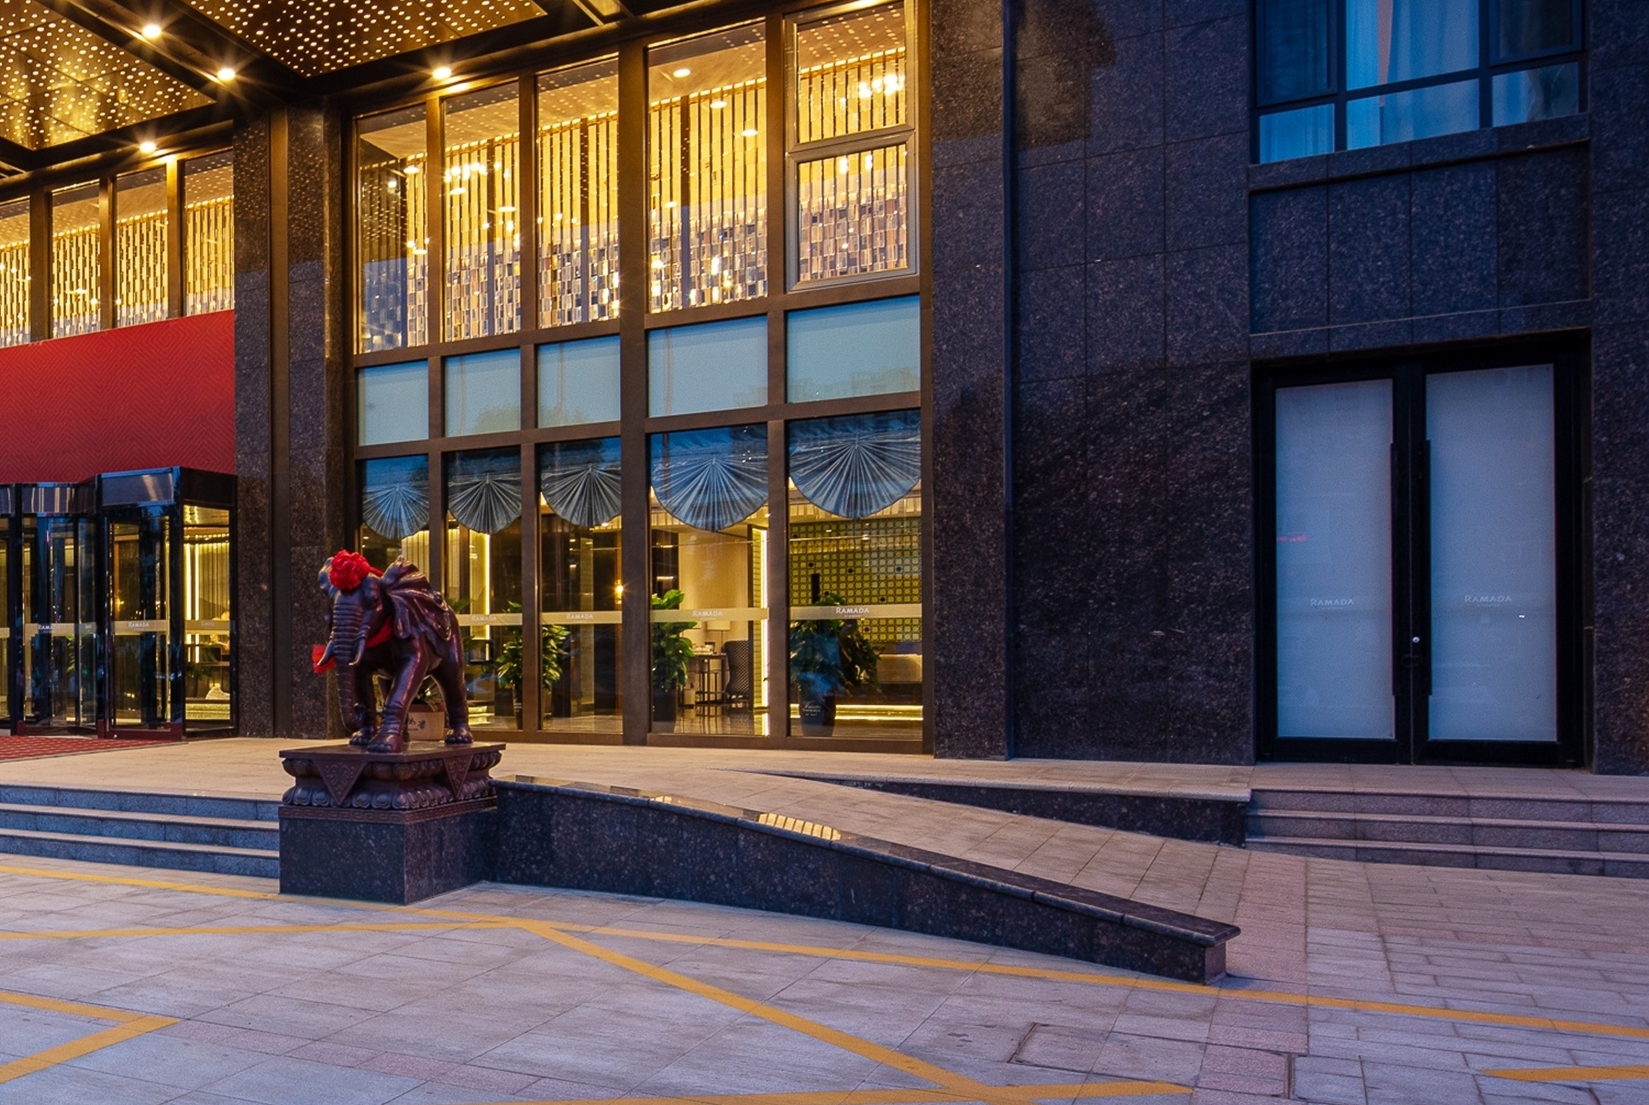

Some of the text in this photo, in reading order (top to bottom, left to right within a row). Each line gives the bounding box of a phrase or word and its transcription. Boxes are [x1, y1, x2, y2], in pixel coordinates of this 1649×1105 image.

[1309, 597, 1355, 606] RAMADA
[1464, 594, 1512, 603] RAMADA
[835, 606, 869, 614] RAMADA
